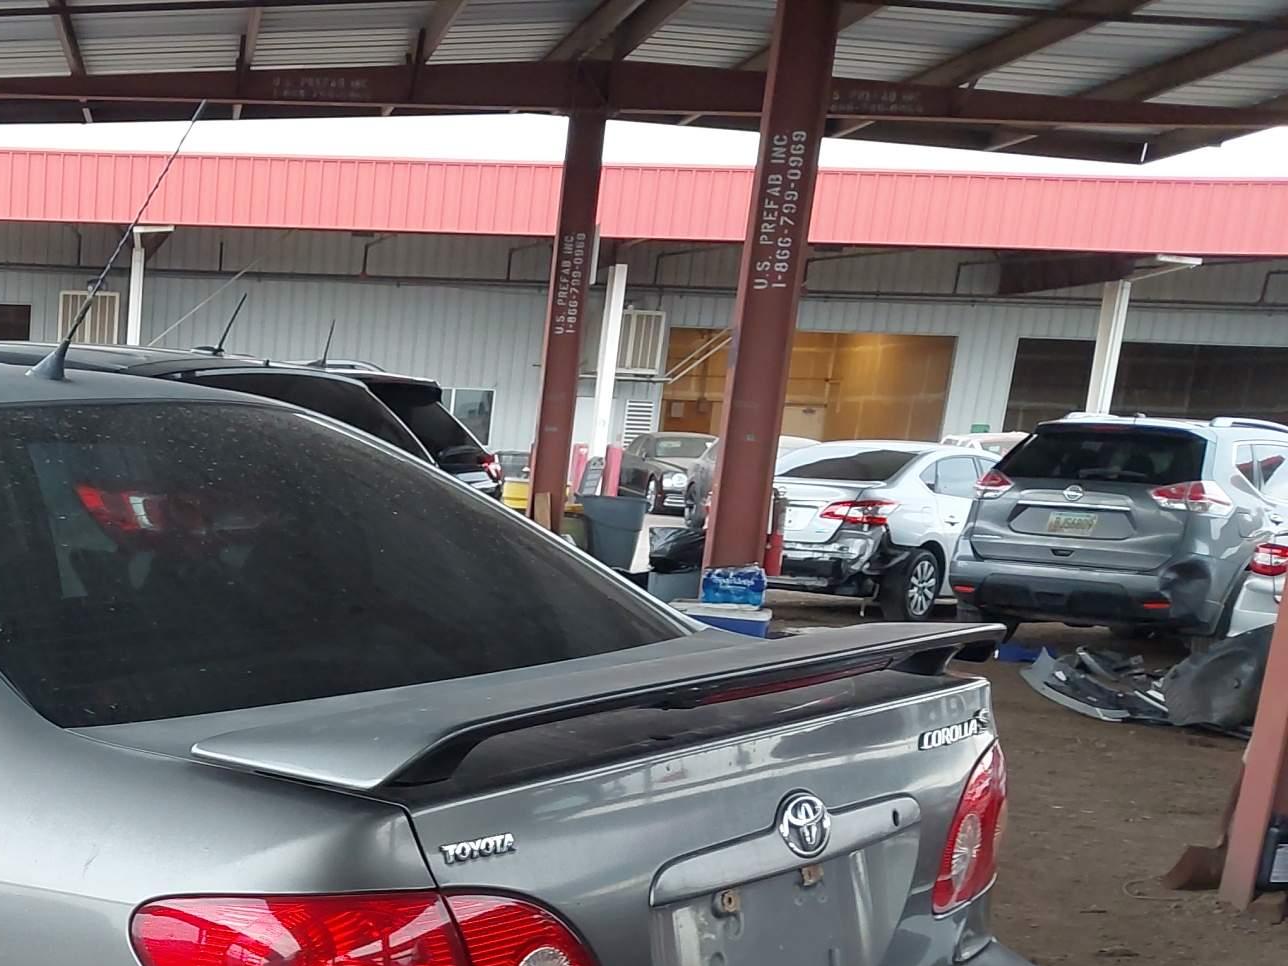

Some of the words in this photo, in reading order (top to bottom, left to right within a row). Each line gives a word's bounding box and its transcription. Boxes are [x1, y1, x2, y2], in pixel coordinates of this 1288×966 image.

[759, 173, 783, 245] PREFAB
[557, 260, 572, 306] PREFAB
[753, 255, 772, 290] U.S.
[919, 718, 978, 750] COROLLA
[440, 832, 516, 864] TOYOTA
